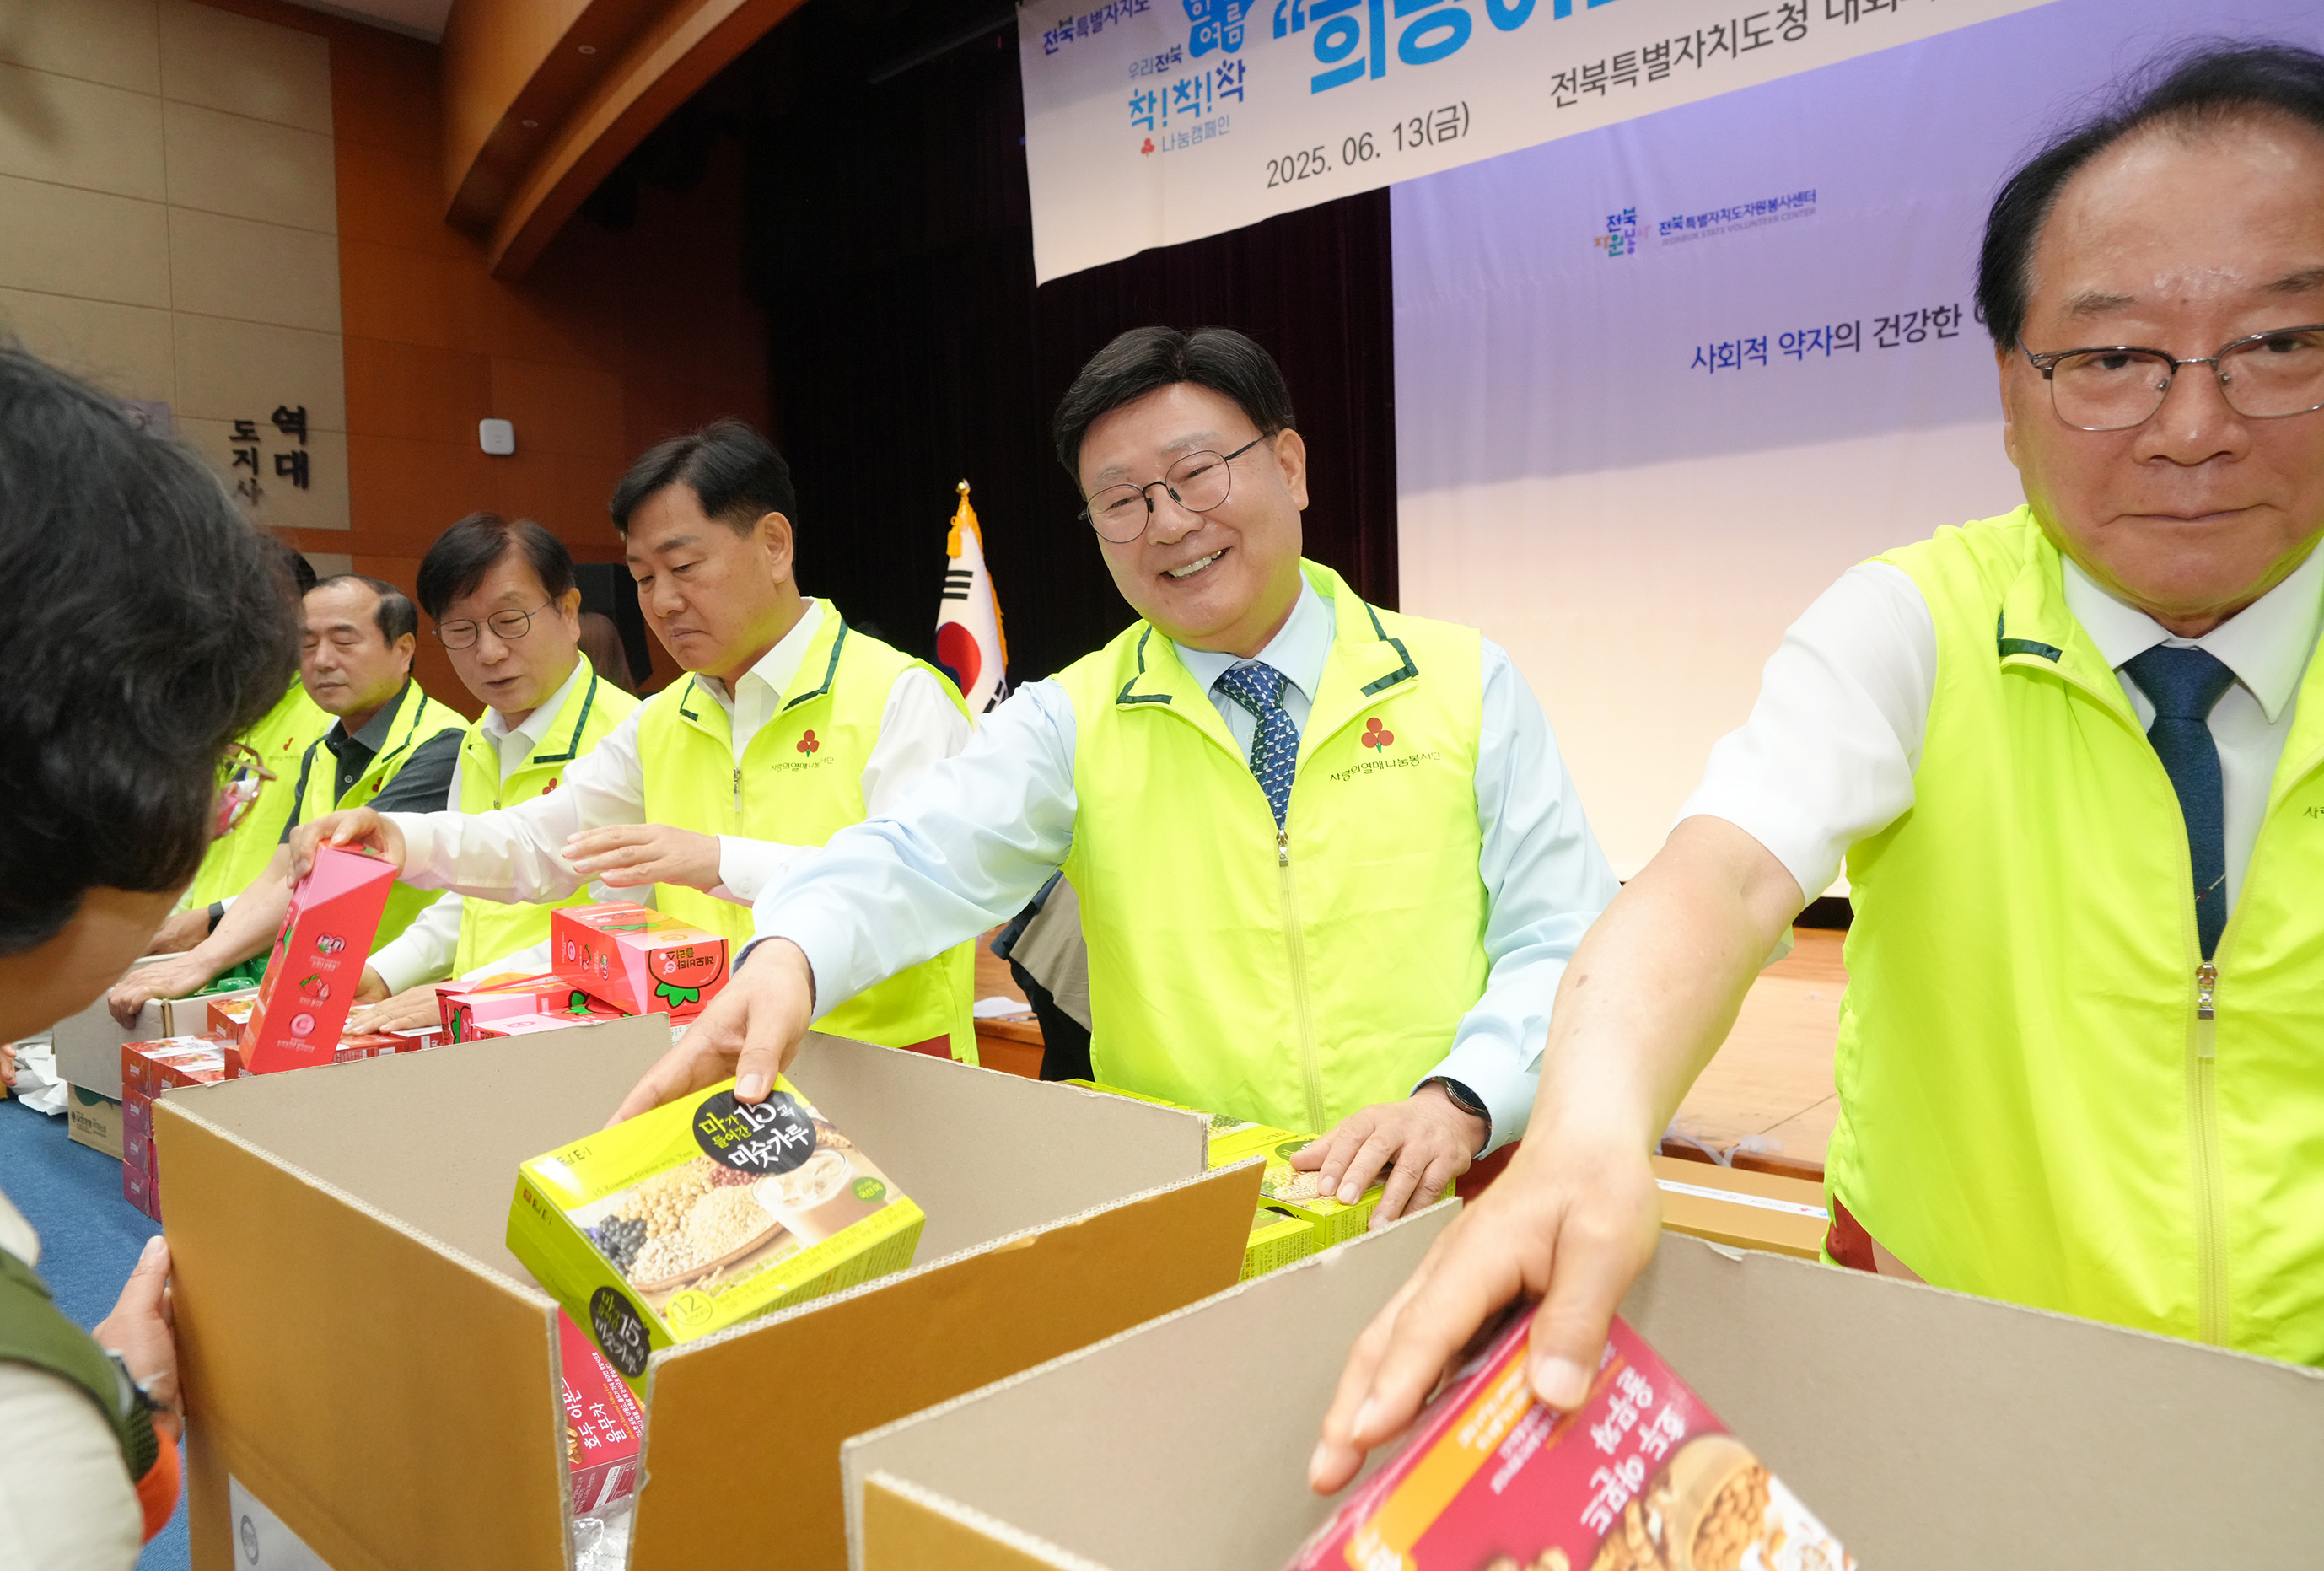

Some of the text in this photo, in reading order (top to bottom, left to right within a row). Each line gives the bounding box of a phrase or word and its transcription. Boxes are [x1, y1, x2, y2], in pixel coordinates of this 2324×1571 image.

[1549, 0, 1810, 109] 전북특별자치도청
[1162, 115, 1230, 153] 나눔캠페인
[1267, 101, 1470, 188] 2025. 06. 13(금)
[1606, 207, 1637, 233] 전북
[1781, 207, 1816, 222] CENTER
[1691, 336, 1768, 374] 사회적
[1778, 320, 1860, 361] 약자의
[1873, 304, 1963, 349] 건강한
[229, 419, 264, 507] 도지사
[271, 405, 309, 491] 역대
[712, 1124, 752, 1149] 들어간
[728, 1123, 810, 1169] 미숫가루
[670, 1294, 703, 1316] 12
[589, 1403, 627, 1443] 율무차
[1590, 1364, 1654, 1455] 율무차
[578, 1422, 602, 1450] 호두
[1579, 1403, 1686, 1536] 호두 아몬드
